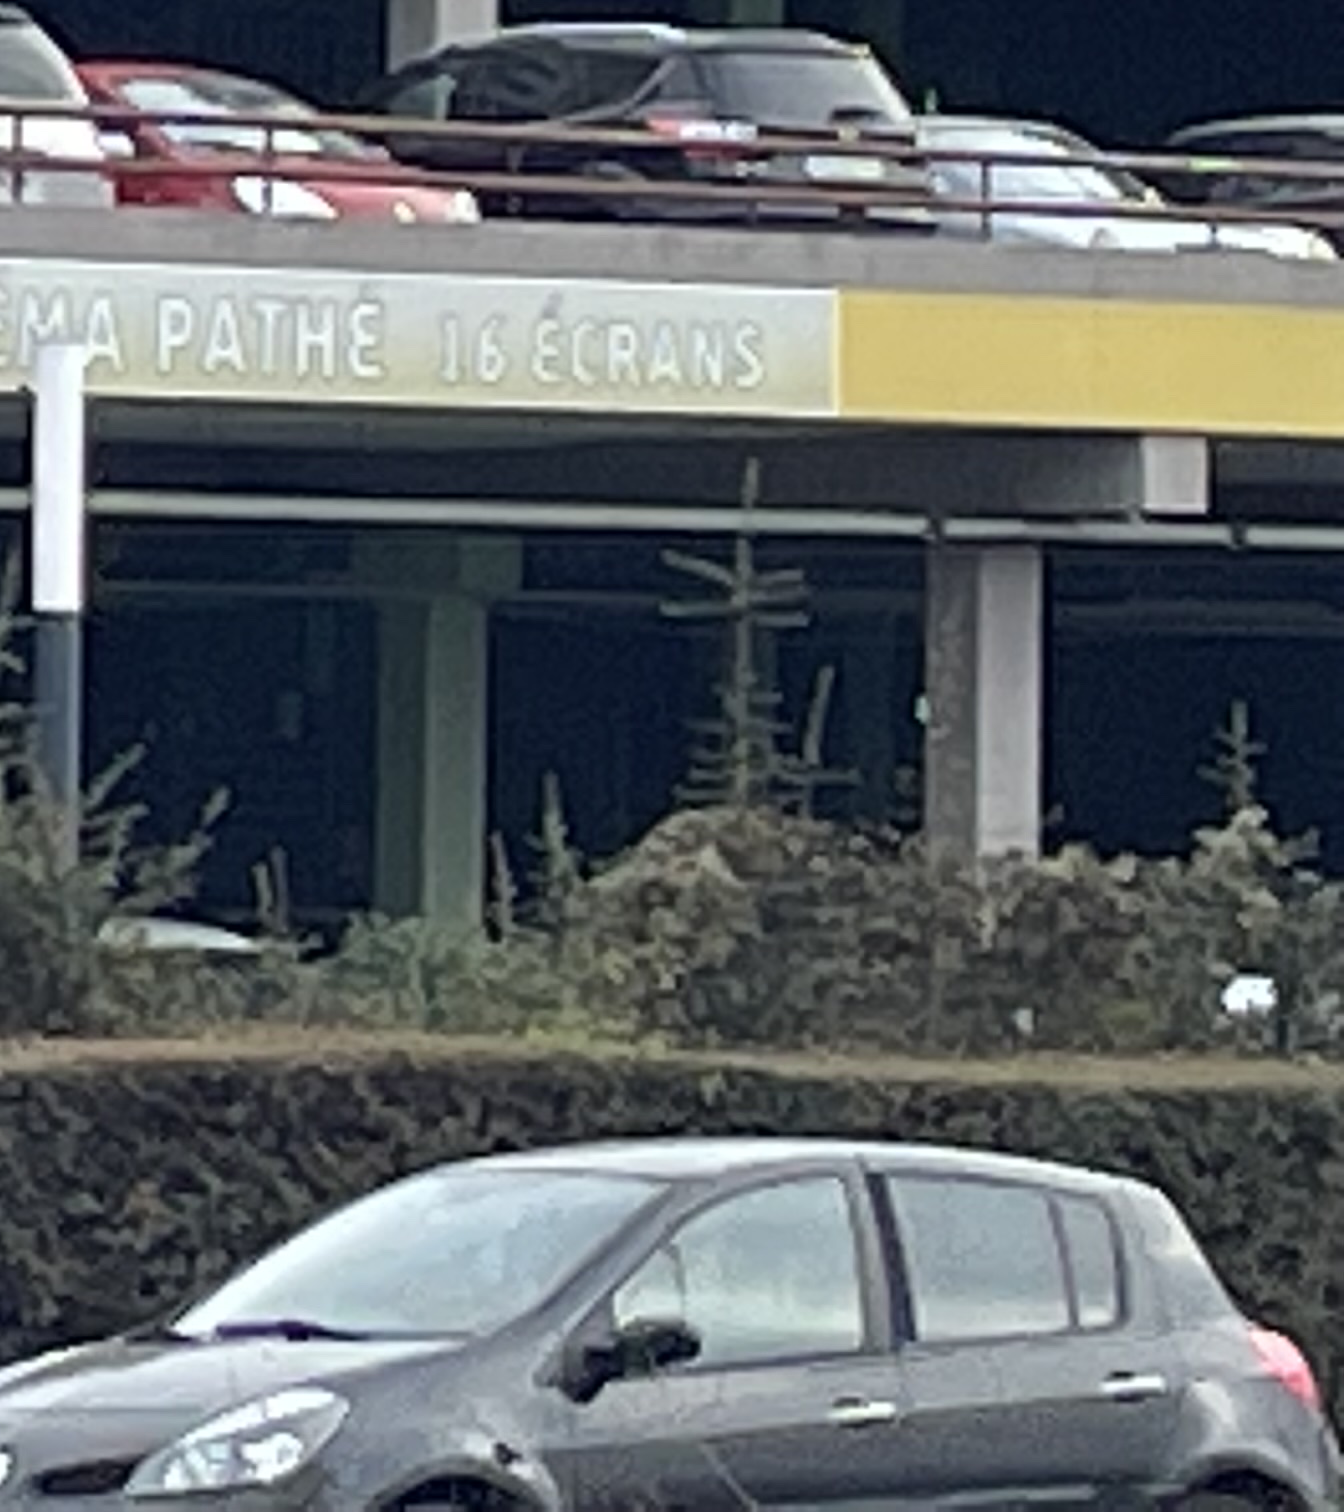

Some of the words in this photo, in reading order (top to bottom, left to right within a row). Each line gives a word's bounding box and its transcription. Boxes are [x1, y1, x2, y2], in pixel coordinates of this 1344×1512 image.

[156, 283, 385, 378] PATHÉ
[440, 312, 505, 384] 16
[532, 294, 766, 389] ÉCRANS
